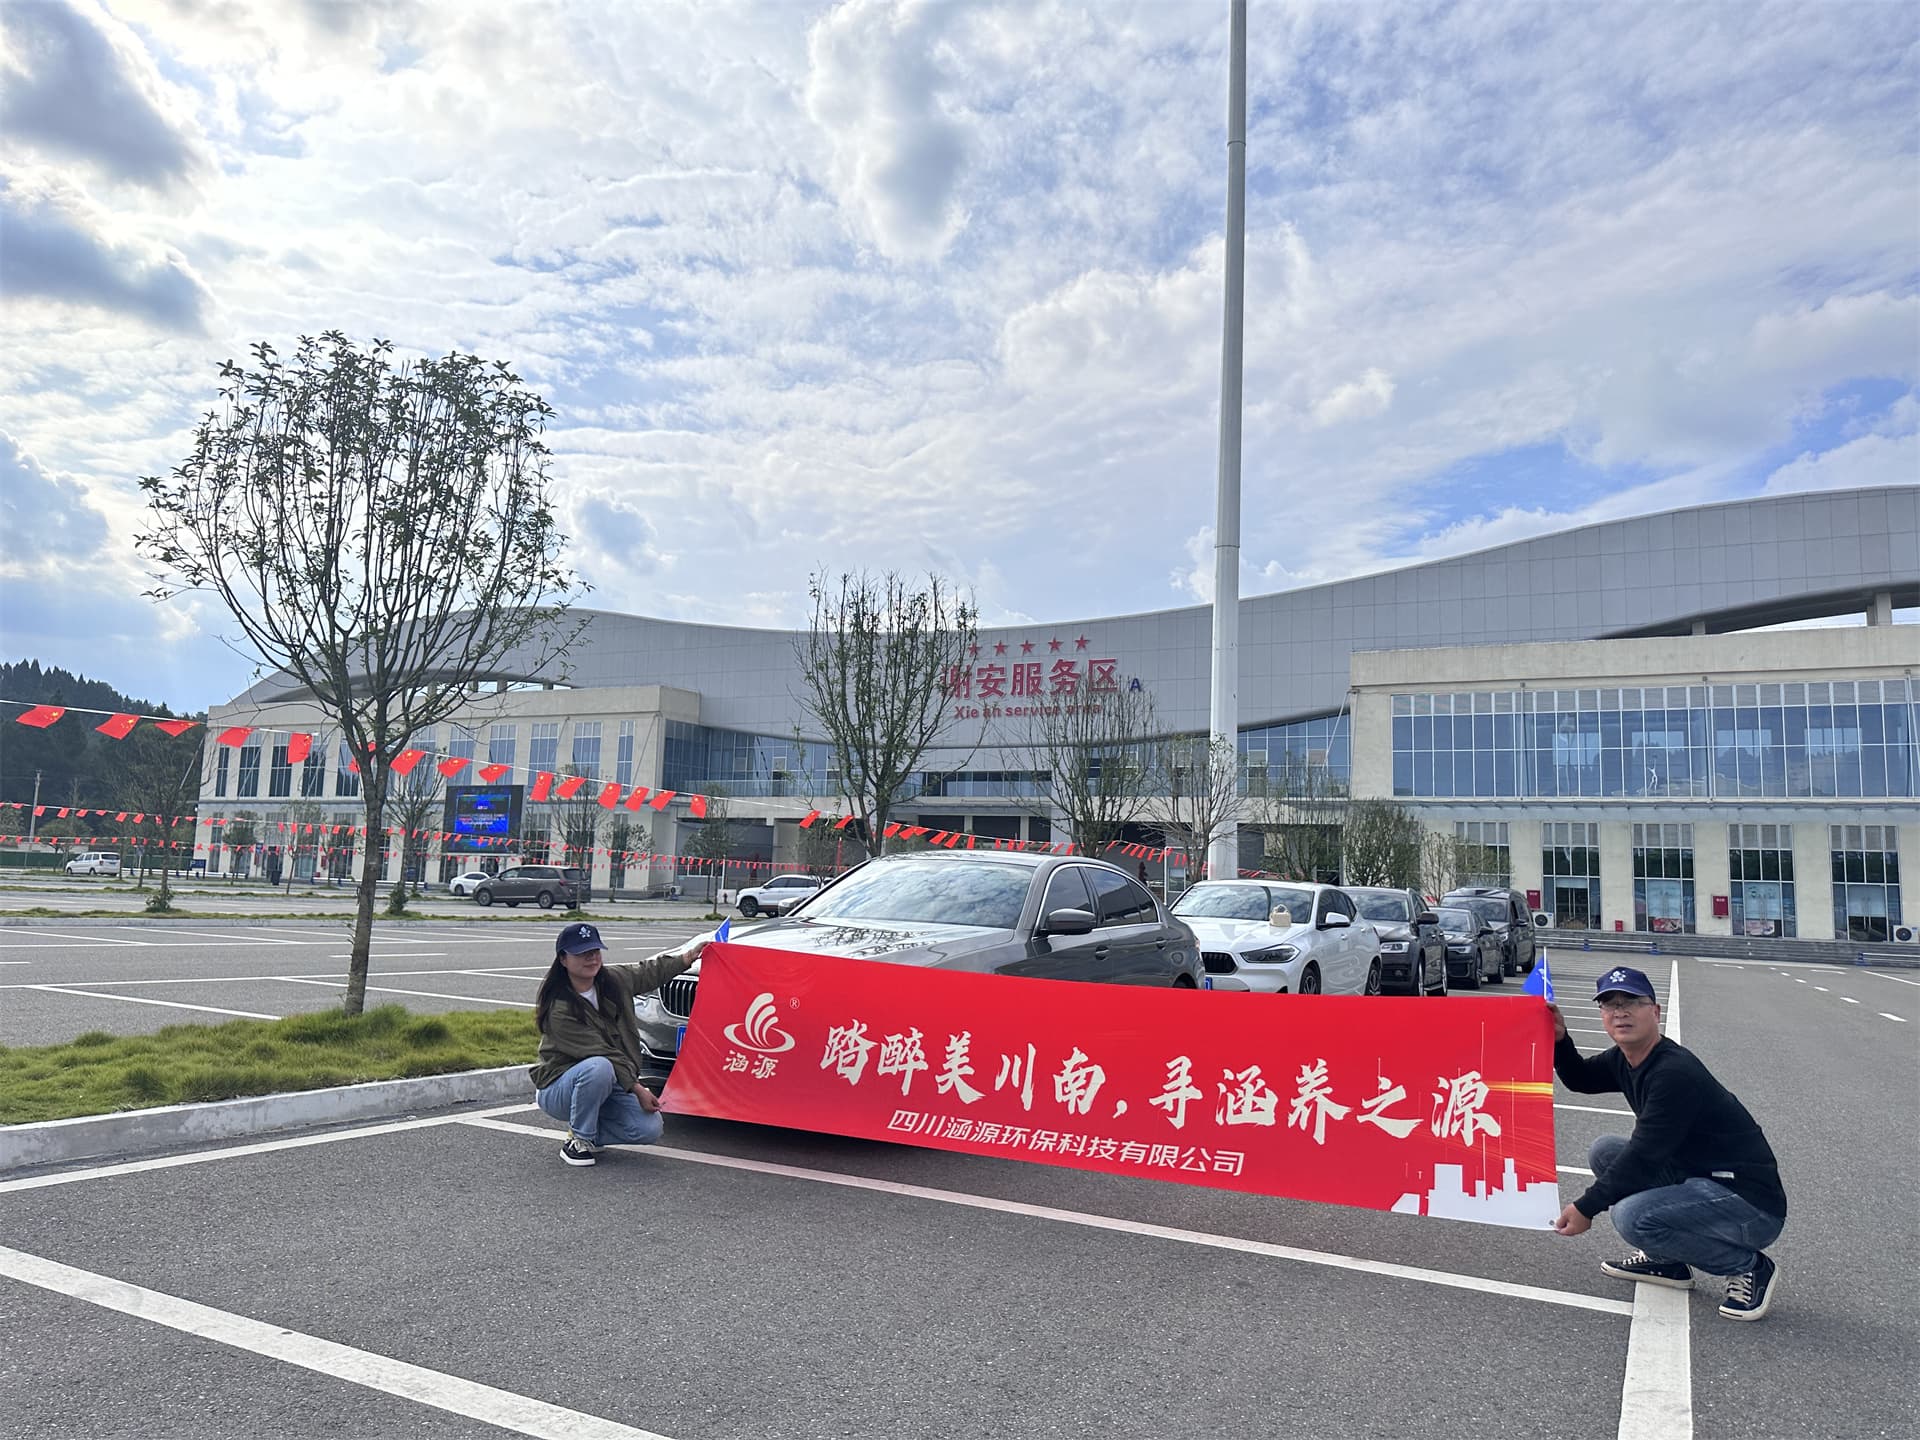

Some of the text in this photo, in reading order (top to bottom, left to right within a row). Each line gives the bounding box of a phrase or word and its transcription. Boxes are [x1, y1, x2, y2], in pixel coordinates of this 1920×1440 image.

[1128, 677, 1142, 692] A
[954, 705, 979, 719] Xie
[1005, 705, 1060, 718] service
[722, 1050, 779, 1079] 涵源
[887, 1109, 1245, 1177] 四川涵源环保科技有限公司
